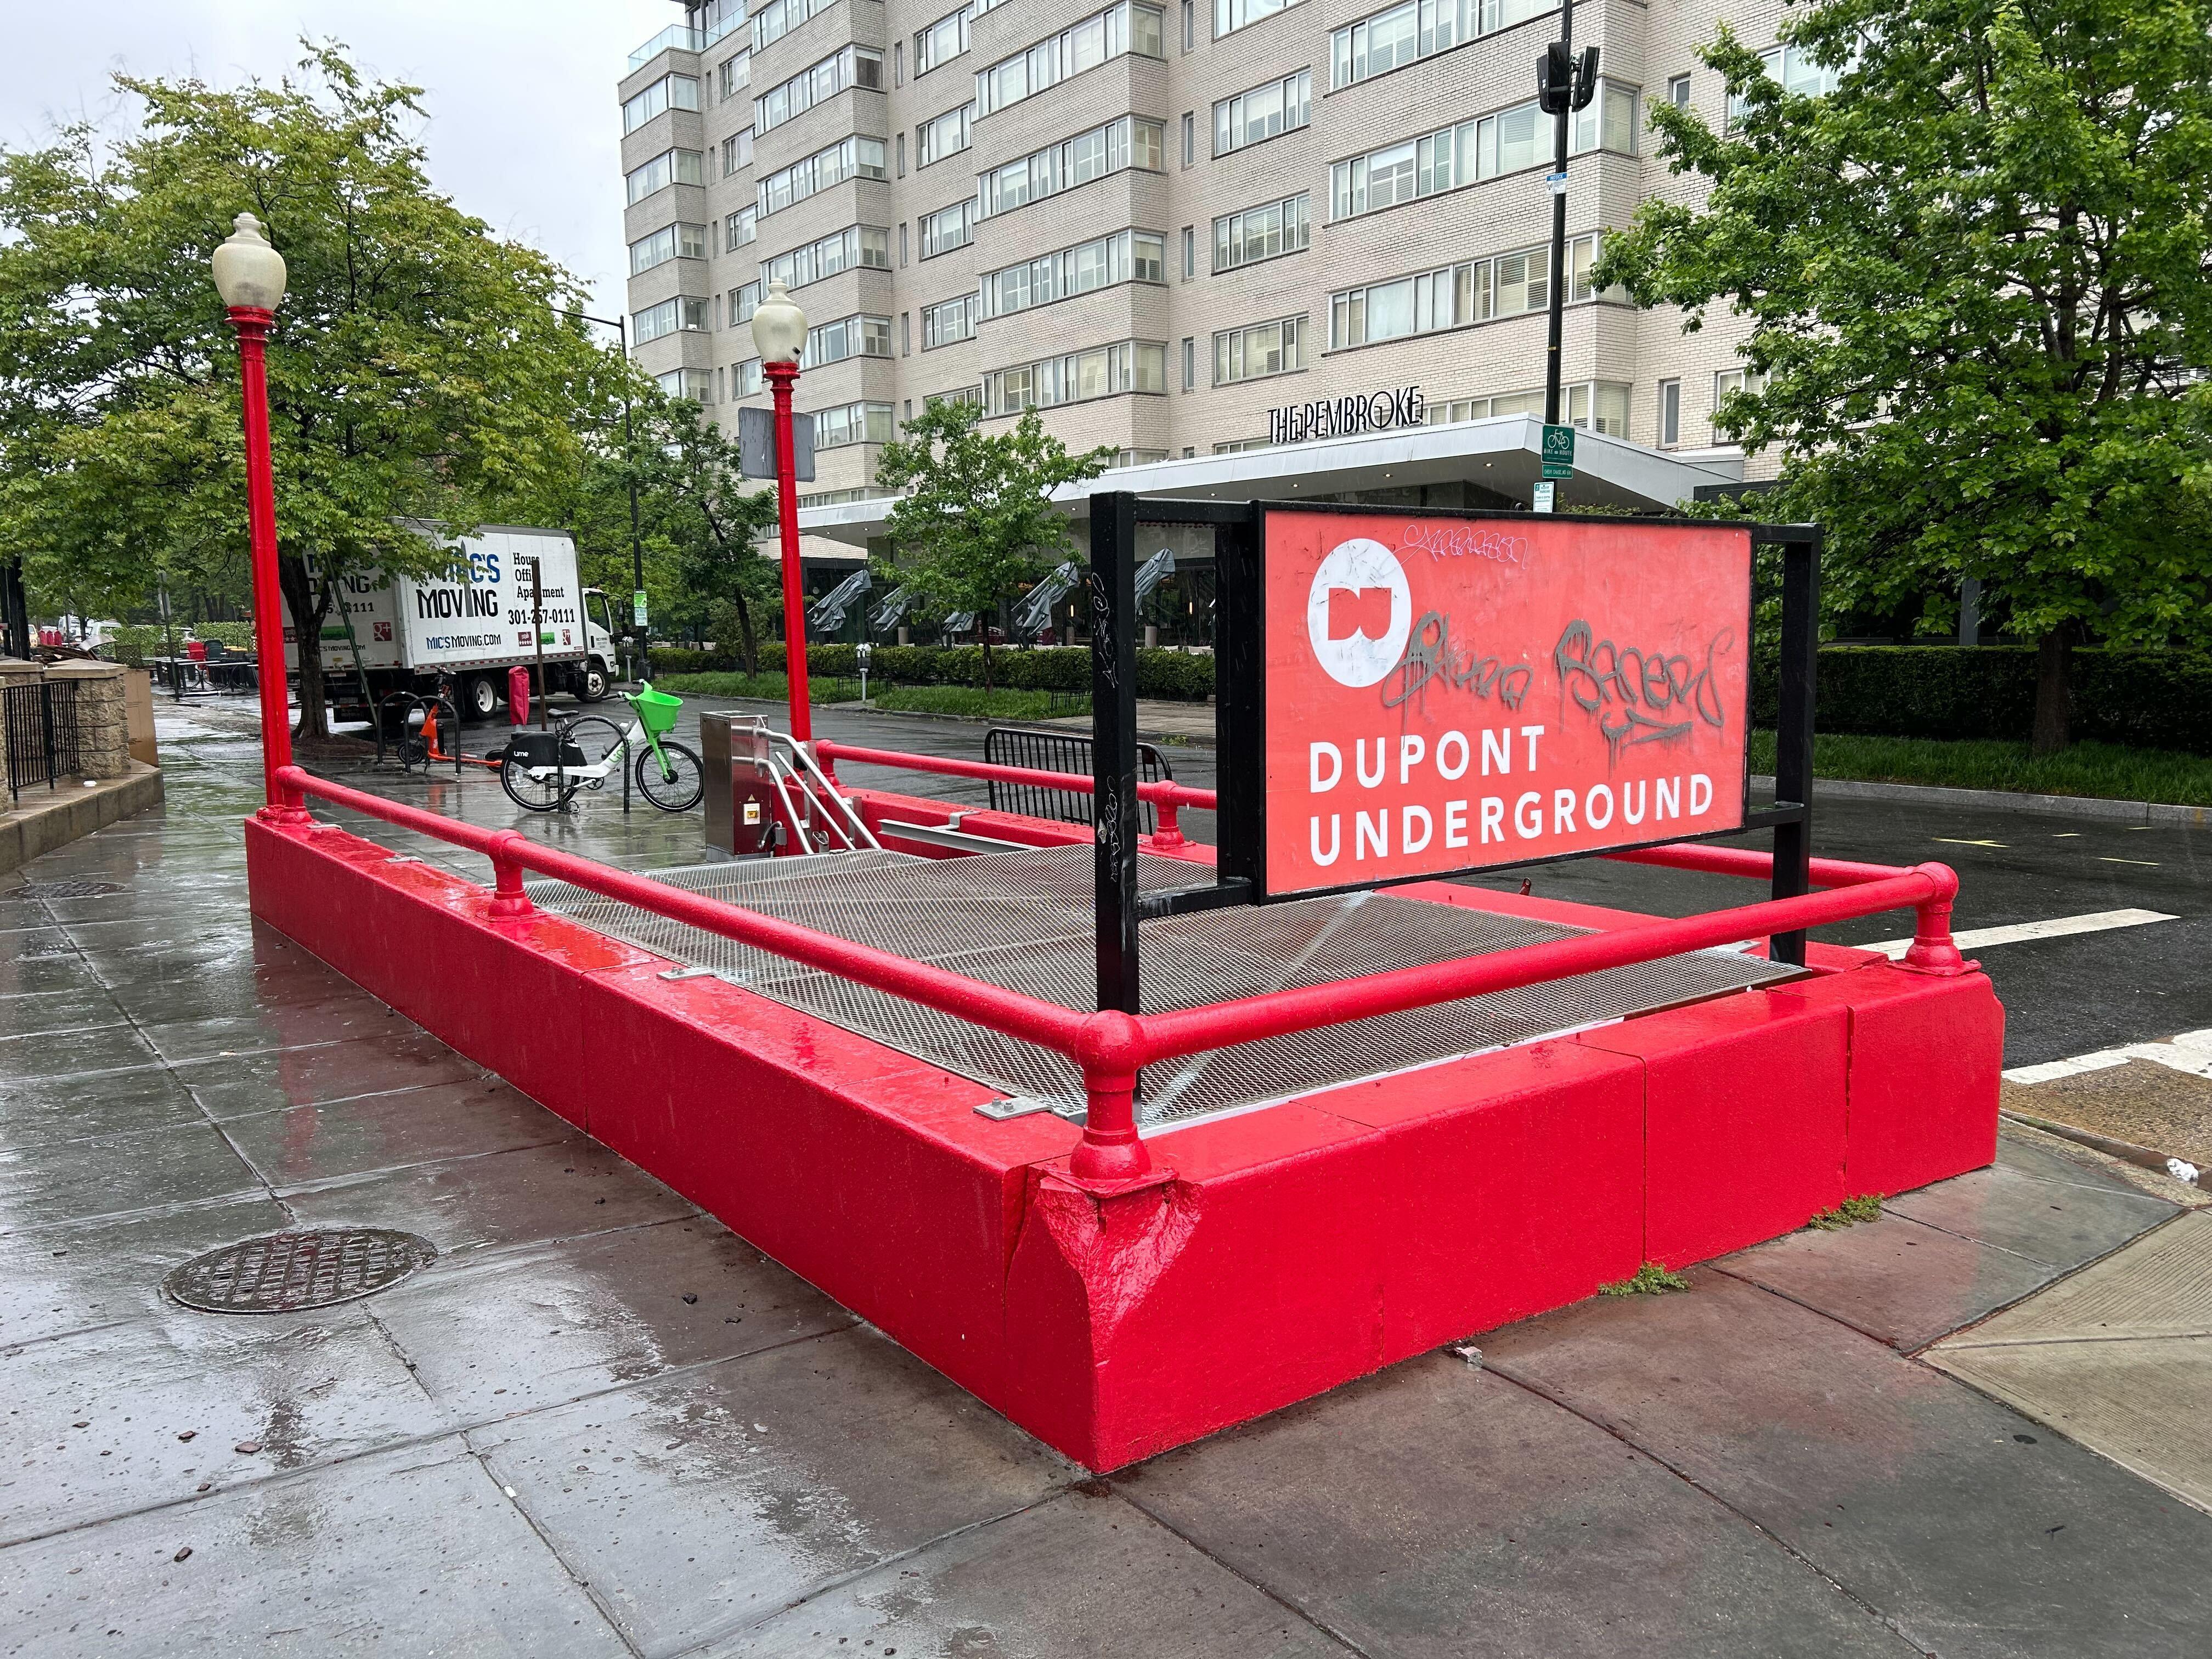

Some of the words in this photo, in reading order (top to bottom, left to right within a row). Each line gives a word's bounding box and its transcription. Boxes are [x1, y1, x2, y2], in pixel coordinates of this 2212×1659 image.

[1267, 405, 1299, 444] THE
[1305, 386, 1421, 439] PEMBROKE
[1310, 725, 1545, 793] DUPONT
[1310, 774, 1713, 866] UNDERGROUND
